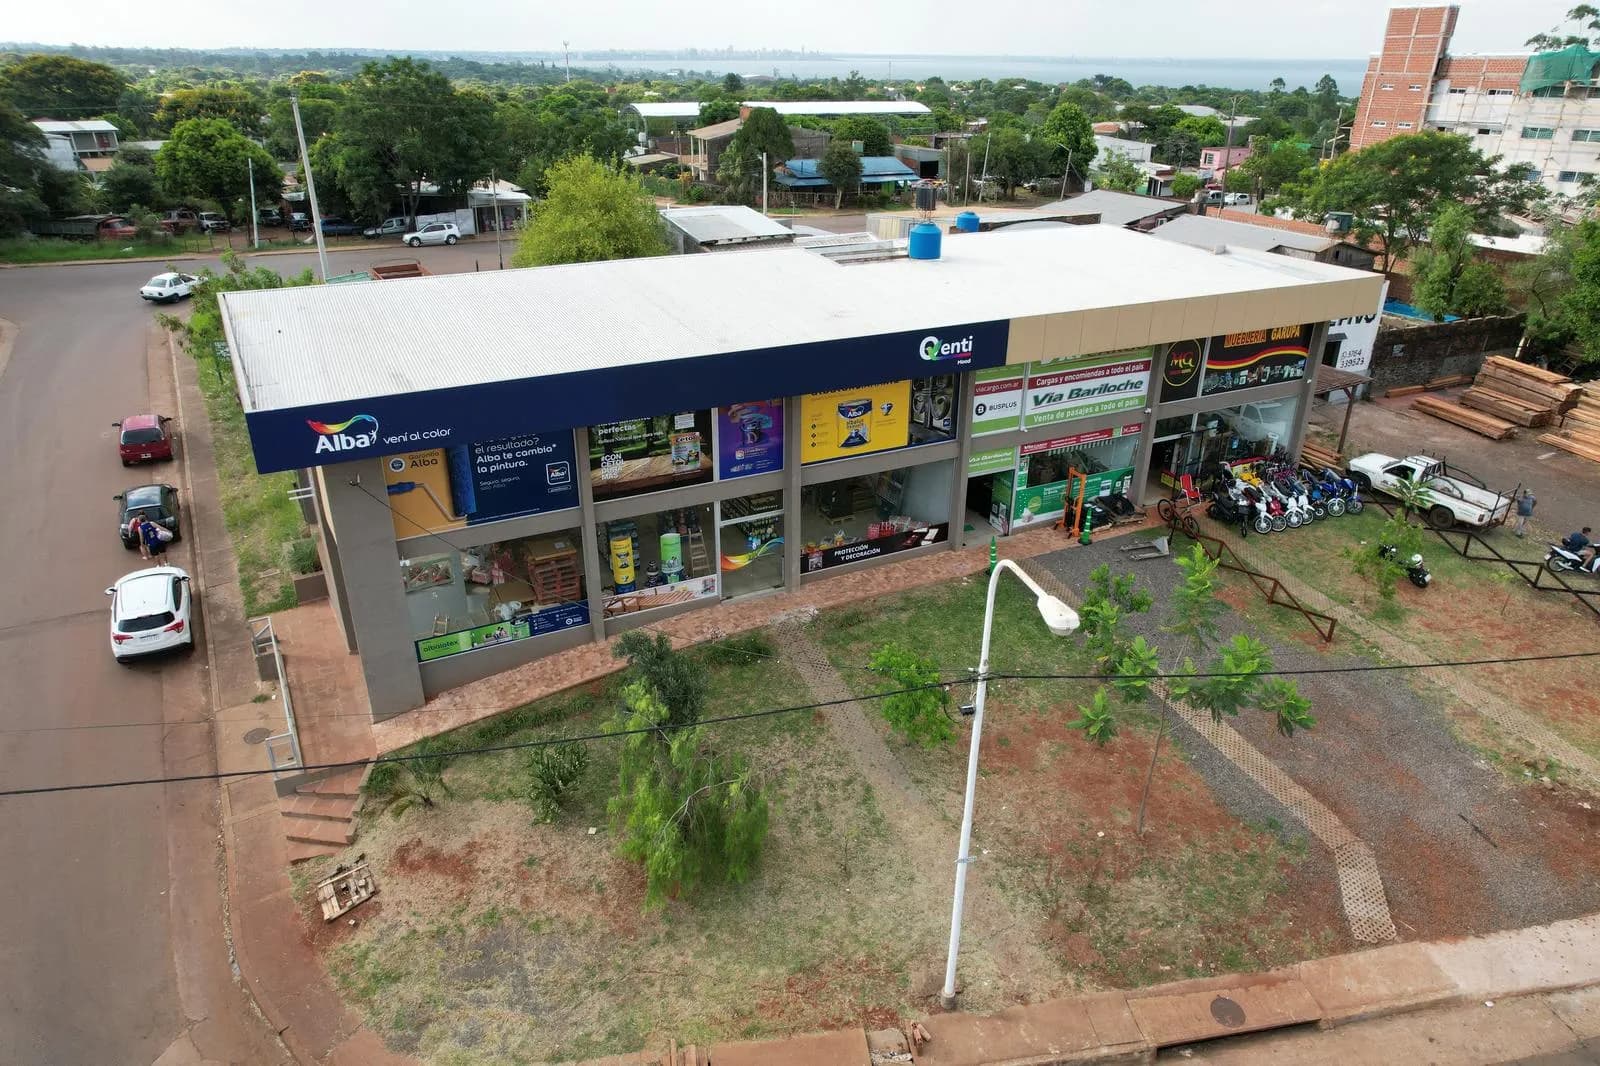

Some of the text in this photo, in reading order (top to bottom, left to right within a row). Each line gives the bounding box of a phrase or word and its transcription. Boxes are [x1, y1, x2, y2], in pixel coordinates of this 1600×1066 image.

[1036, 376, 1058, 386] Cargas
[1064, 369, 1105, 383] encomiendas
[1110, 366, 1126, 375] todo
[1067, 379, 1144, 400] Bariloche
[989, 401, 1017, 411] BUSPLUS
[1033, 412, 1054, 424] Venta
[1055, 411, 1065, 420] de
[1066, 406, 1094, 420] pasajes
[1100, 402, 1116, 412] todo
[409, 430, 421, 441] al
[422, 428, 451, 439] color
[315, 433, 371, 454] Alba
[475, 446, 486, 455] el
[486, 437, 540, 453] resultado?
[410, 459, 439, 469] Alba
[476, 453, 501, 464] Alba
[502, 451, 513, 460] te
[477, 465, 488, 474] la
[834, 544, 869, 557] PROTECCIÓN
[846, 547, 881, 561] DECORACIÓN
